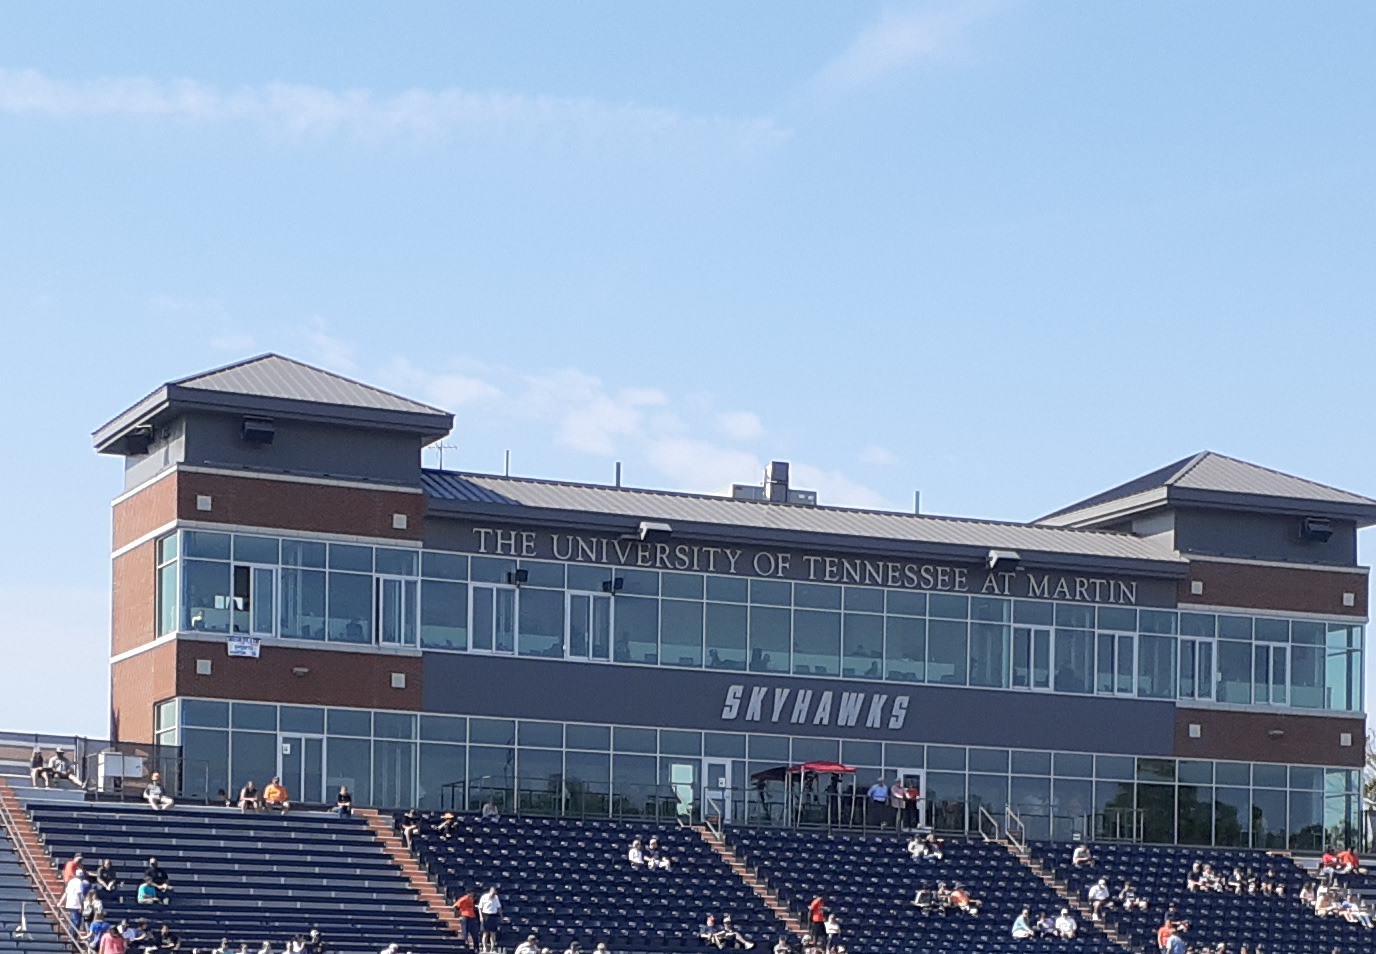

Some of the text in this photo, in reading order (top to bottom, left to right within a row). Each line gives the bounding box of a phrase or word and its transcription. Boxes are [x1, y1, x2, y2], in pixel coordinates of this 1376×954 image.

[472, 527, 1138, 605] THE UNIVERSITY OF TENNESSEE AT MARTIN
[721, 684, 910, 730] SKYHAWKS
